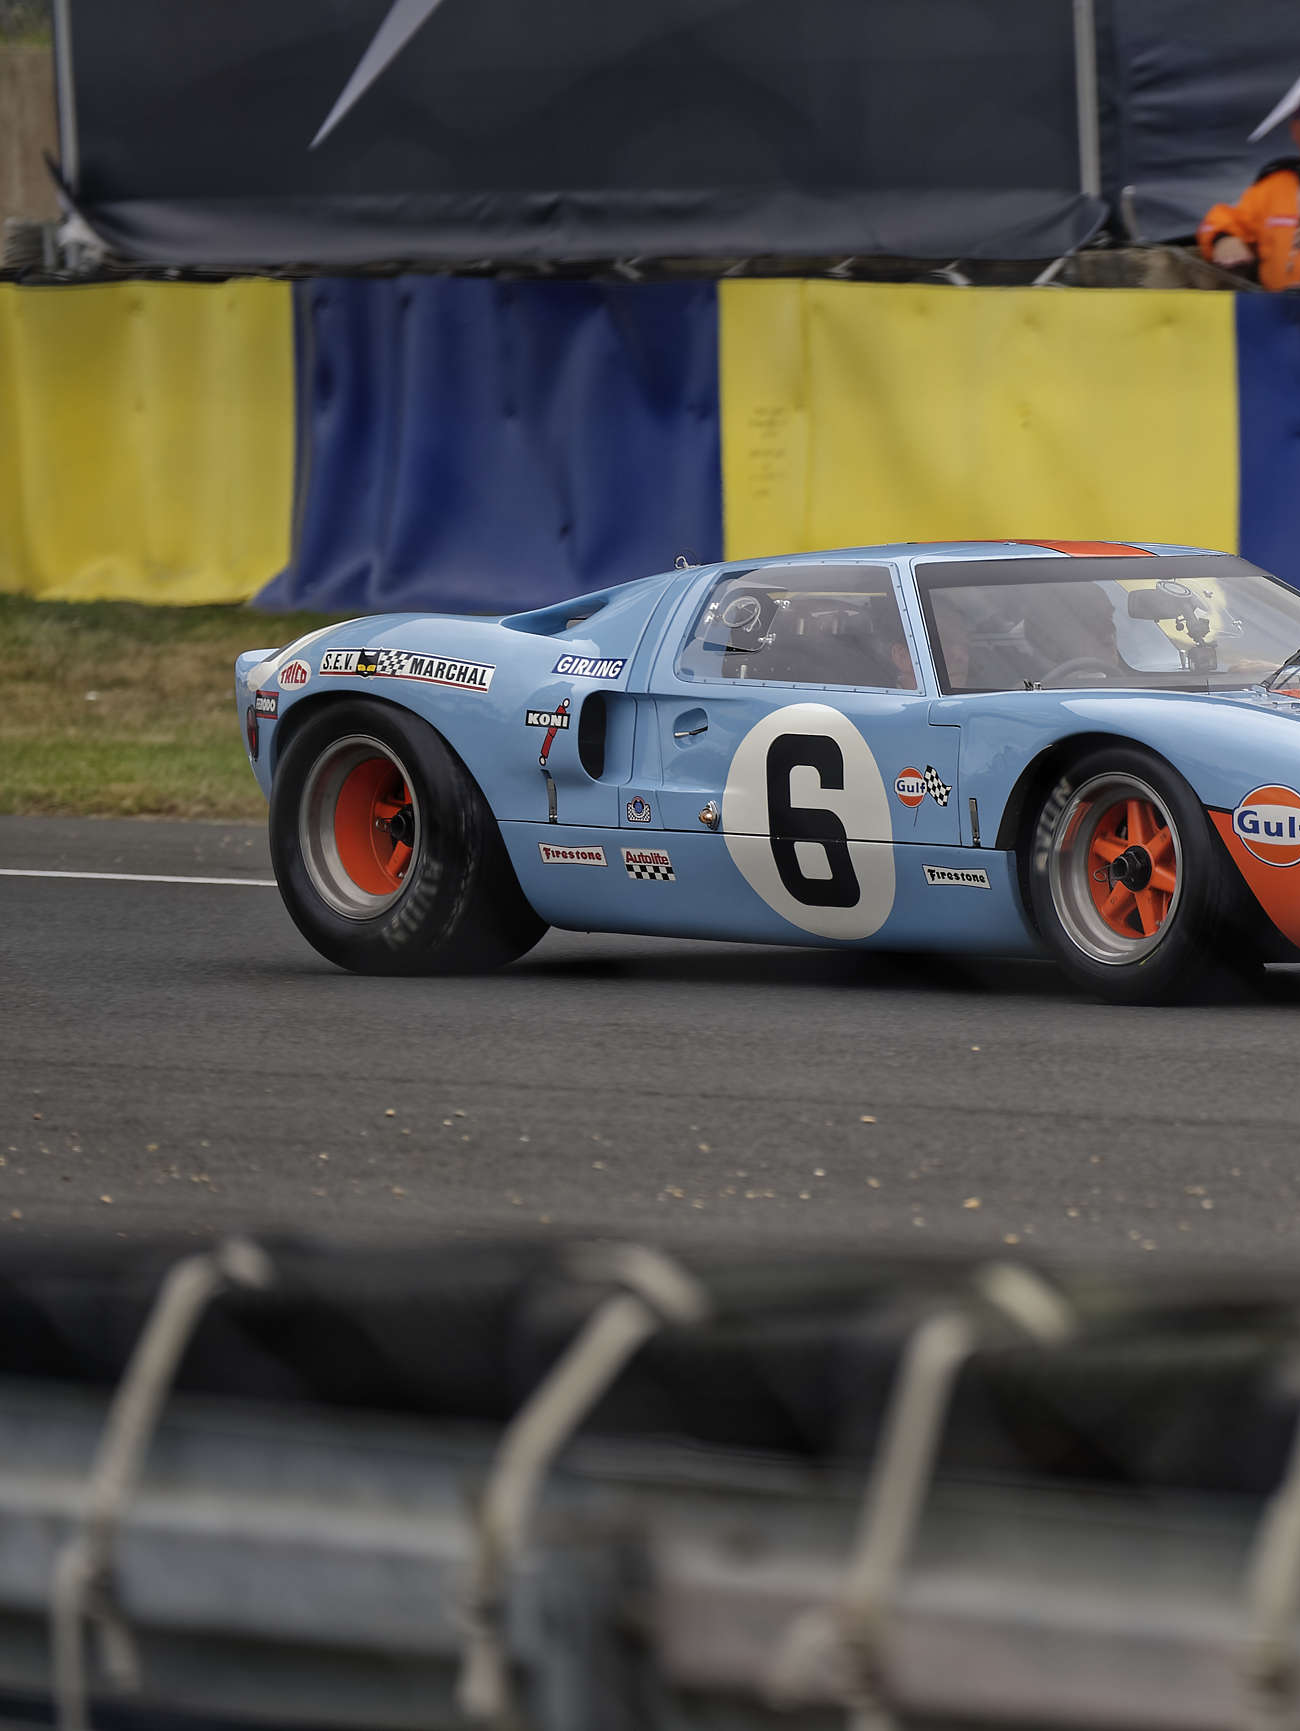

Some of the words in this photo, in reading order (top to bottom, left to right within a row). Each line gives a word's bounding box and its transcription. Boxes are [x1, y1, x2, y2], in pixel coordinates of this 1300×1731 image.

[280, 661, 308, 684] TRICO
[322, 653, 353, 670] S.E.V.
[409, 657, 487, 687] MARCHAL
[557, 656, 623, 678] GIRLING
[527, 712, 569, 728] KONI
[896, 779, 926, 794] Gulf
[766, 733, 861, 908] 6
[542, 847, 603, 861] Firestone
[625, 850, 670, 866] Autolite
[927, 868, 986, 884] Firestone
